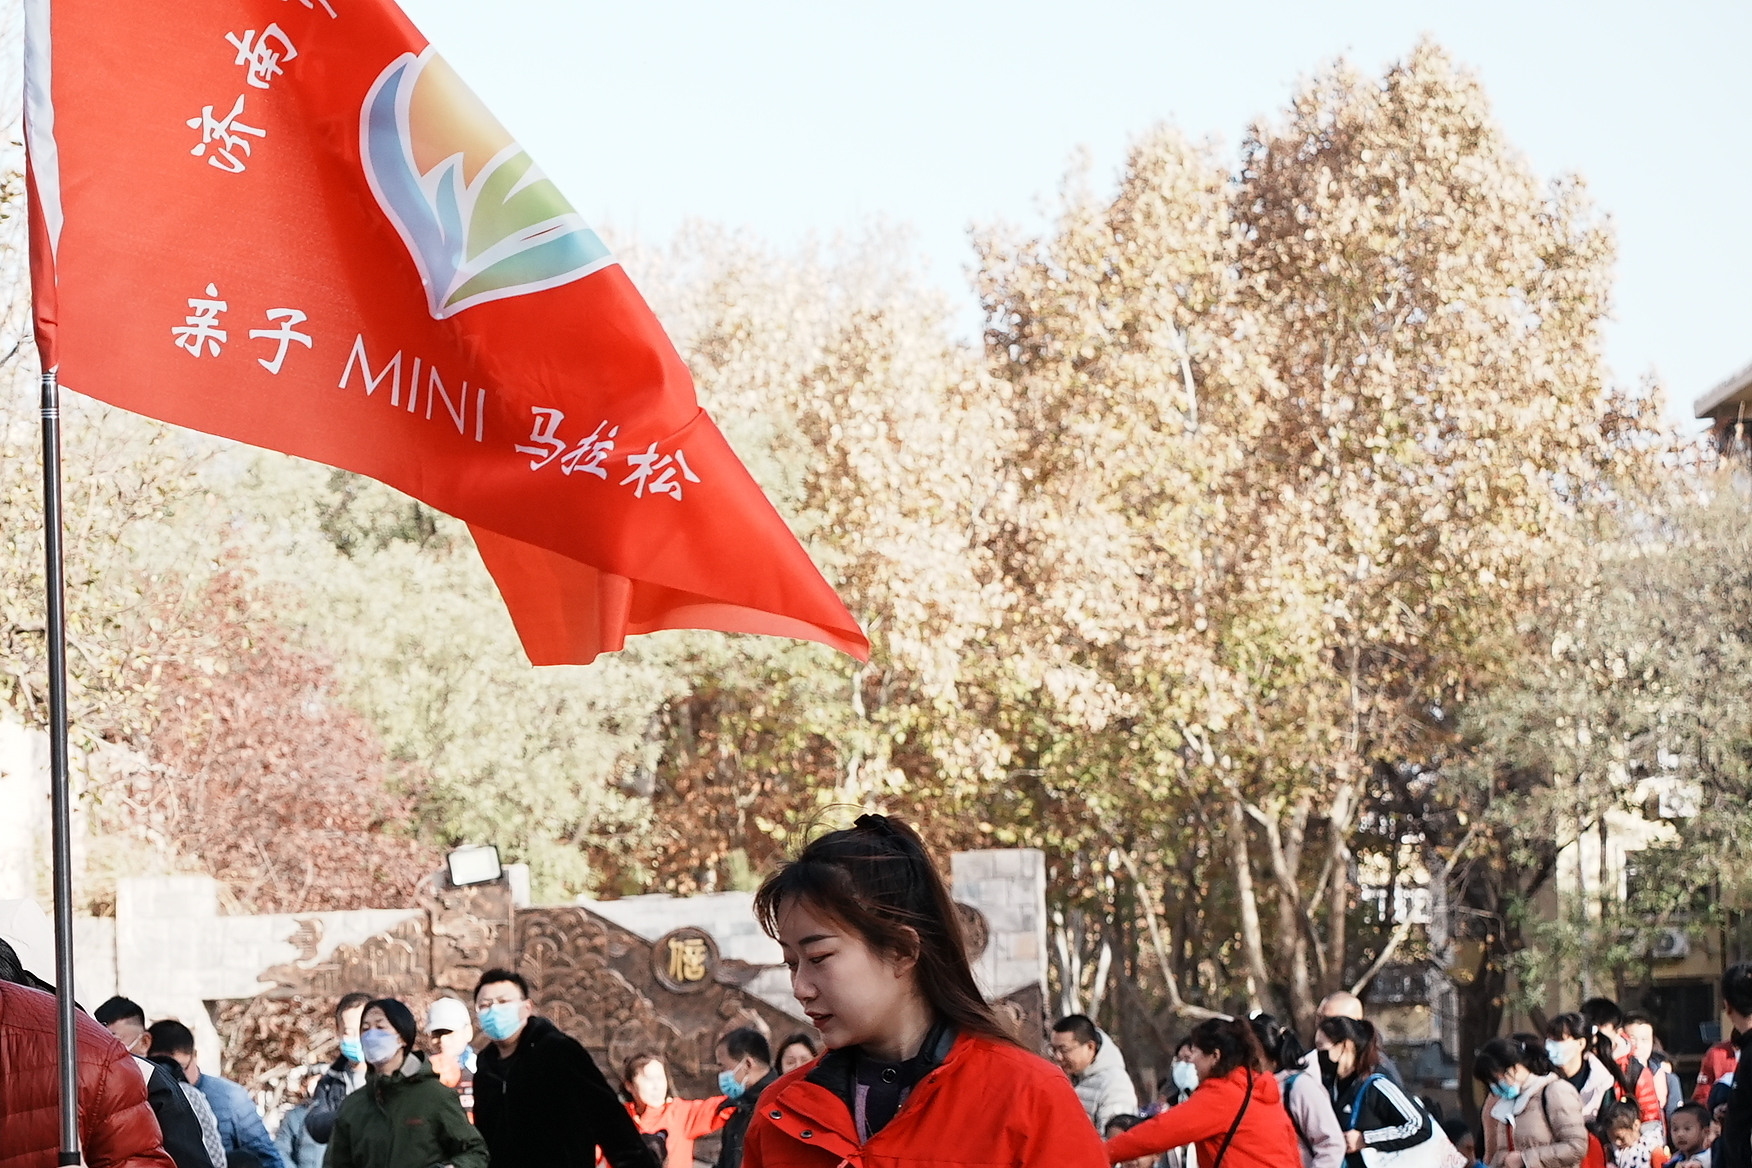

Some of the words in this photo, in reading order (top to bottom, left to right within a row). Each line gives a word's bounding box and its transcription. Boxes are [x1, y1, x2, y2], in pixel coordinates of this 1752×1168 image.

[185, 0, 338, 174] 济南
[171, 283, 313, 375] 亲子
[338, 333, 486, 443] MINI
[514, 405, 701, 502] 马拉松
